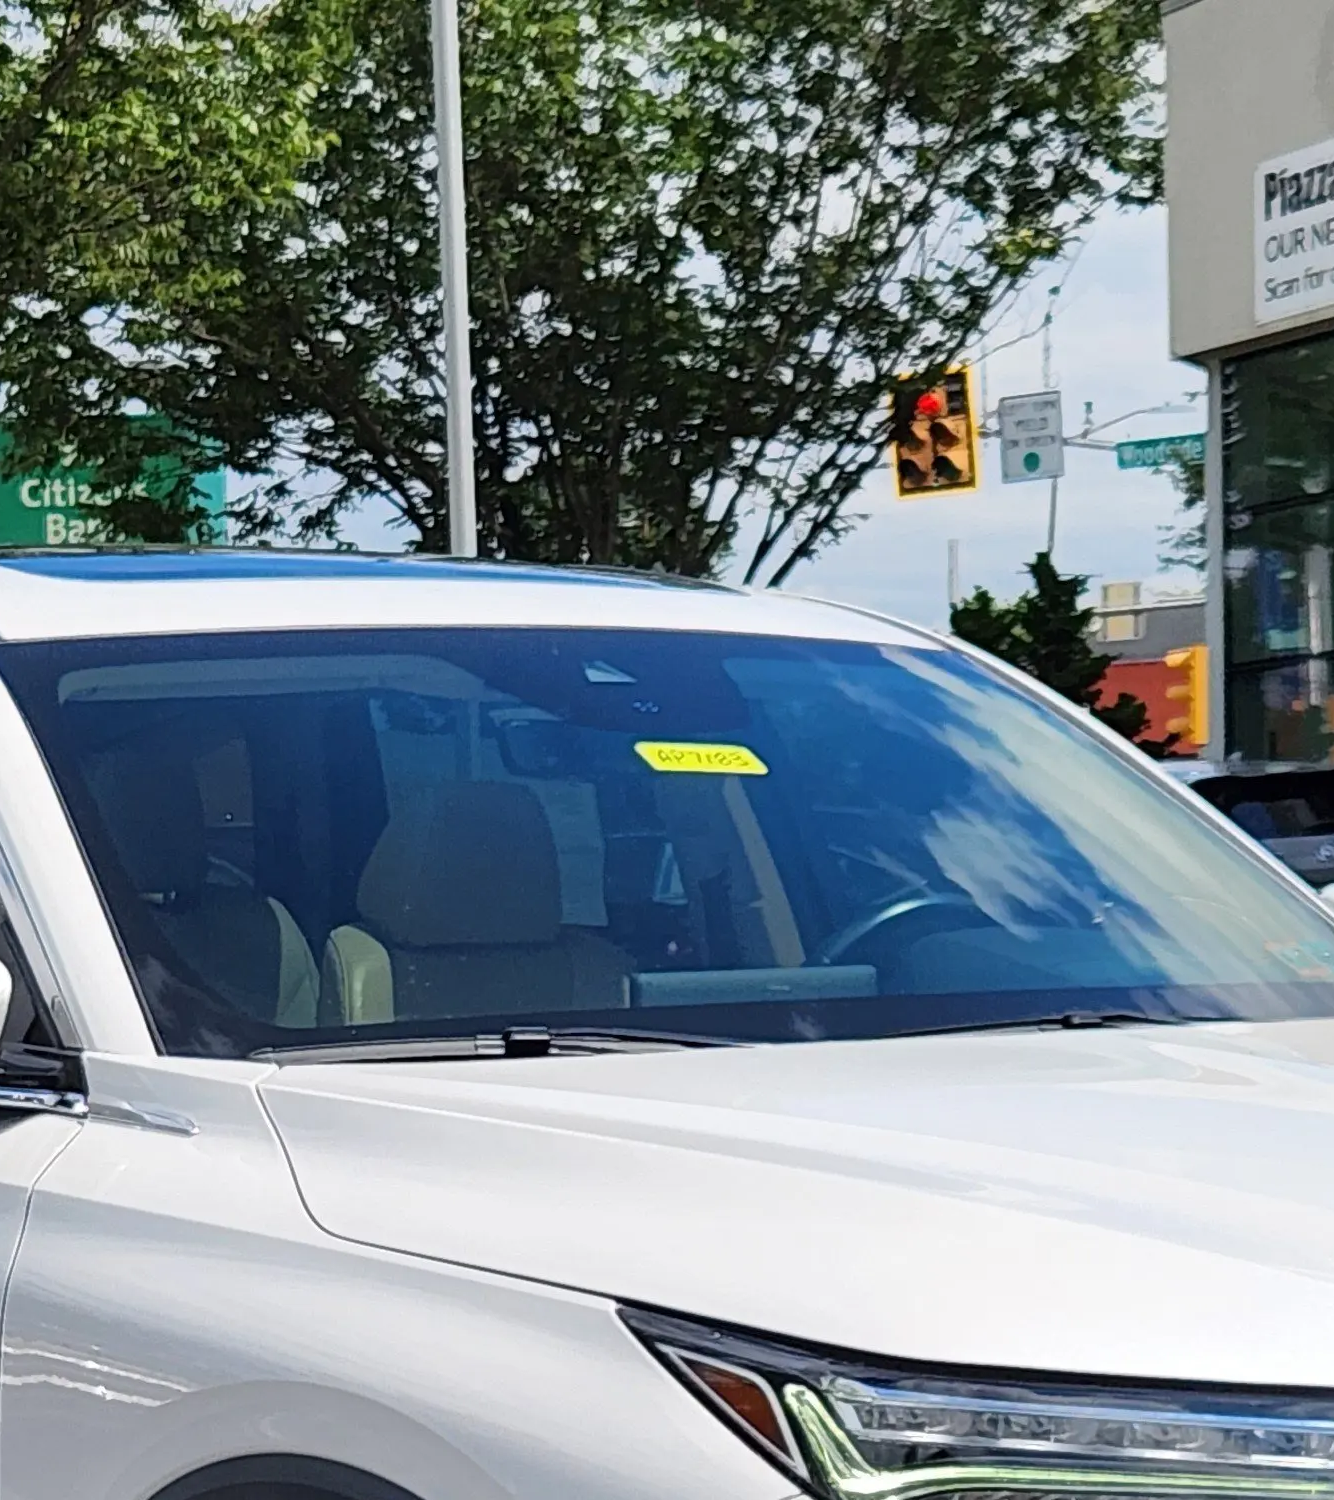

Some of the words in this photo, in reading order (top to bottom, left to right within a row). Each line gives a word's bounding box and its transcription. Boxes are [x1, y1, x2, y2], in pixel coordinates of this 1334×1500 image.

[1263, 227, 1306, 263] OUR
[1264, 274, 1300, 303] Scan
[1302, 265, 1325, 291] for
[45, 512, 127, 545] Ban
